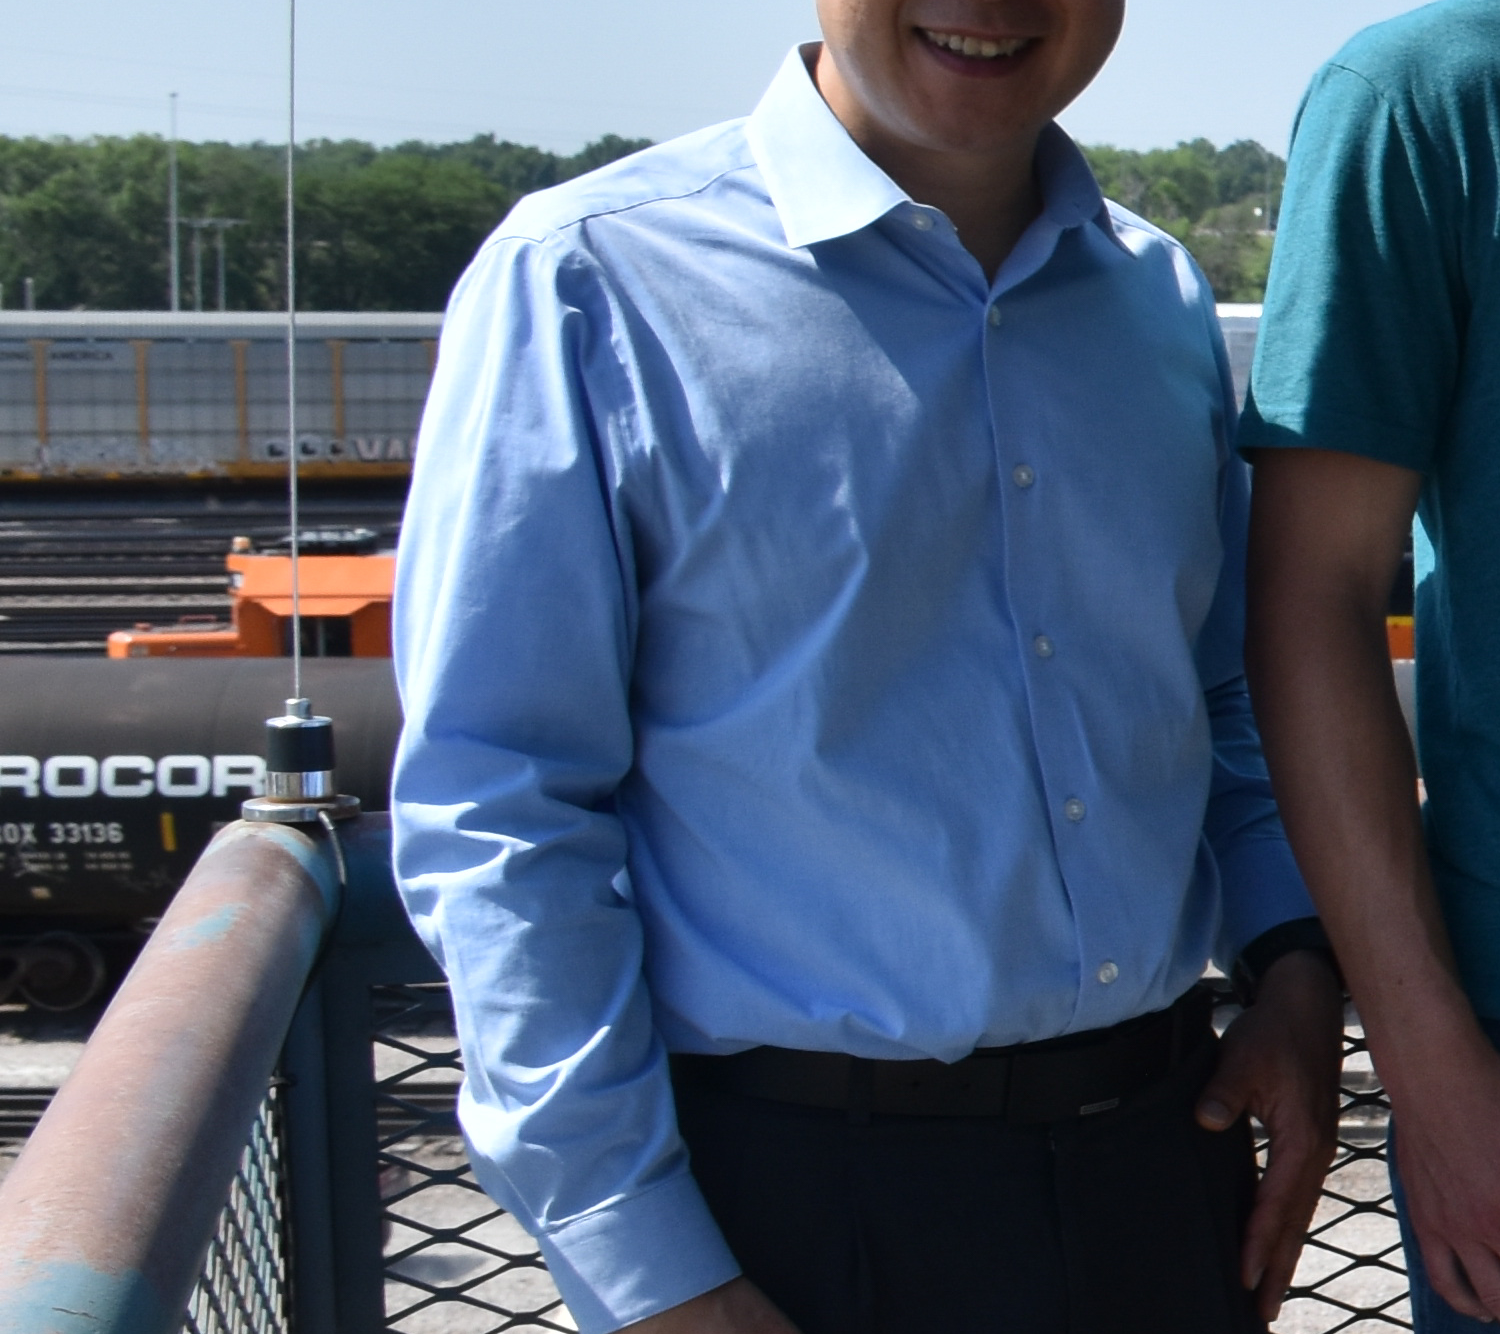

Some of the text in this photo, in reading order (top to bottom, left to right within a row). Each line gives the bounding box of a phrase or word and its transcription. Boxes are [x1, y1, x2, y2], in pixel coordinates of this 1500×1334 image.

[0, 755, 266, 797] ROCOR
[0, 822, 124, 844] OX 33136
